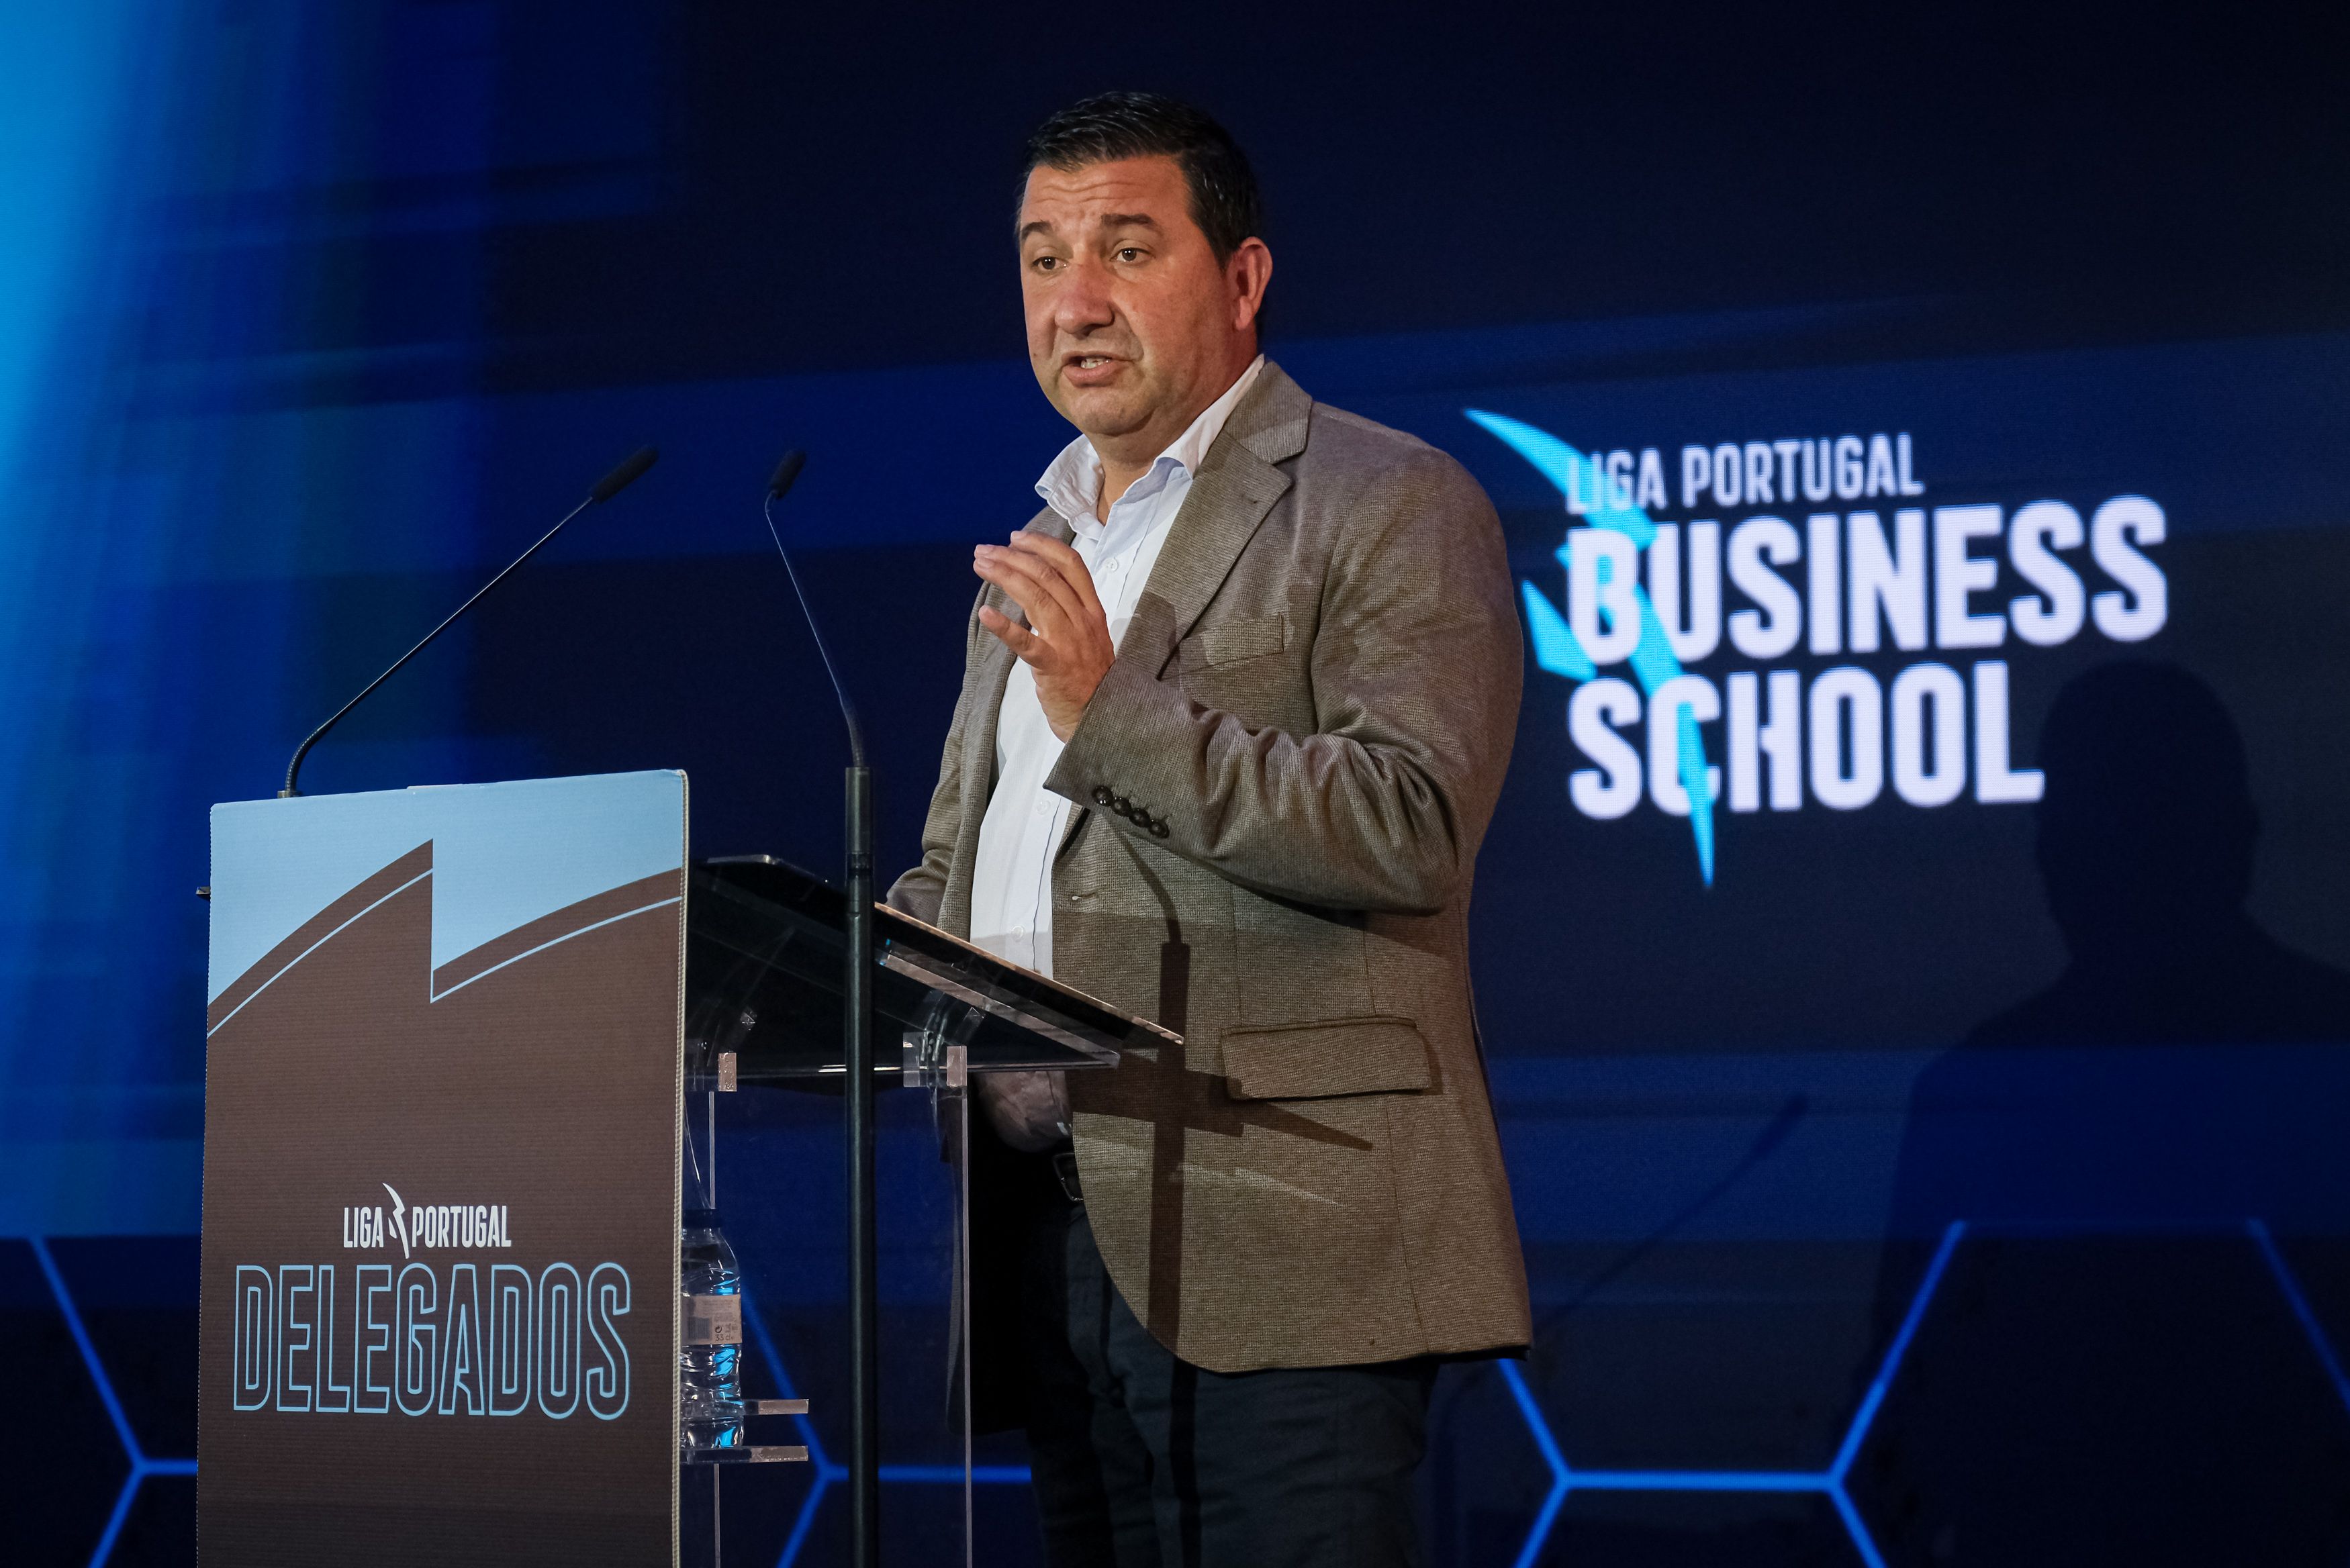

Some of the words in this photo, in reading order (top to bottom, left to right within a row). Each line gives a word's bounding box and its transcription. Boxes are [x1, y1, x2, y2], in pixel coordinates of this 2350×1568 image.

[1566, 447, 1667, 515] LIGA
[1681, 433, 1924, 508] PORTUGAL
[1567, 495, 2167, 665] BUSINESS
[1568, 660, 2045, 820] SCHOOL
[343, 1207, 385, 1248] LIGA
[412, 1205, 512, 1248] PORTUGAL
[233, 1262, 631, 1420] DELEGADOS
